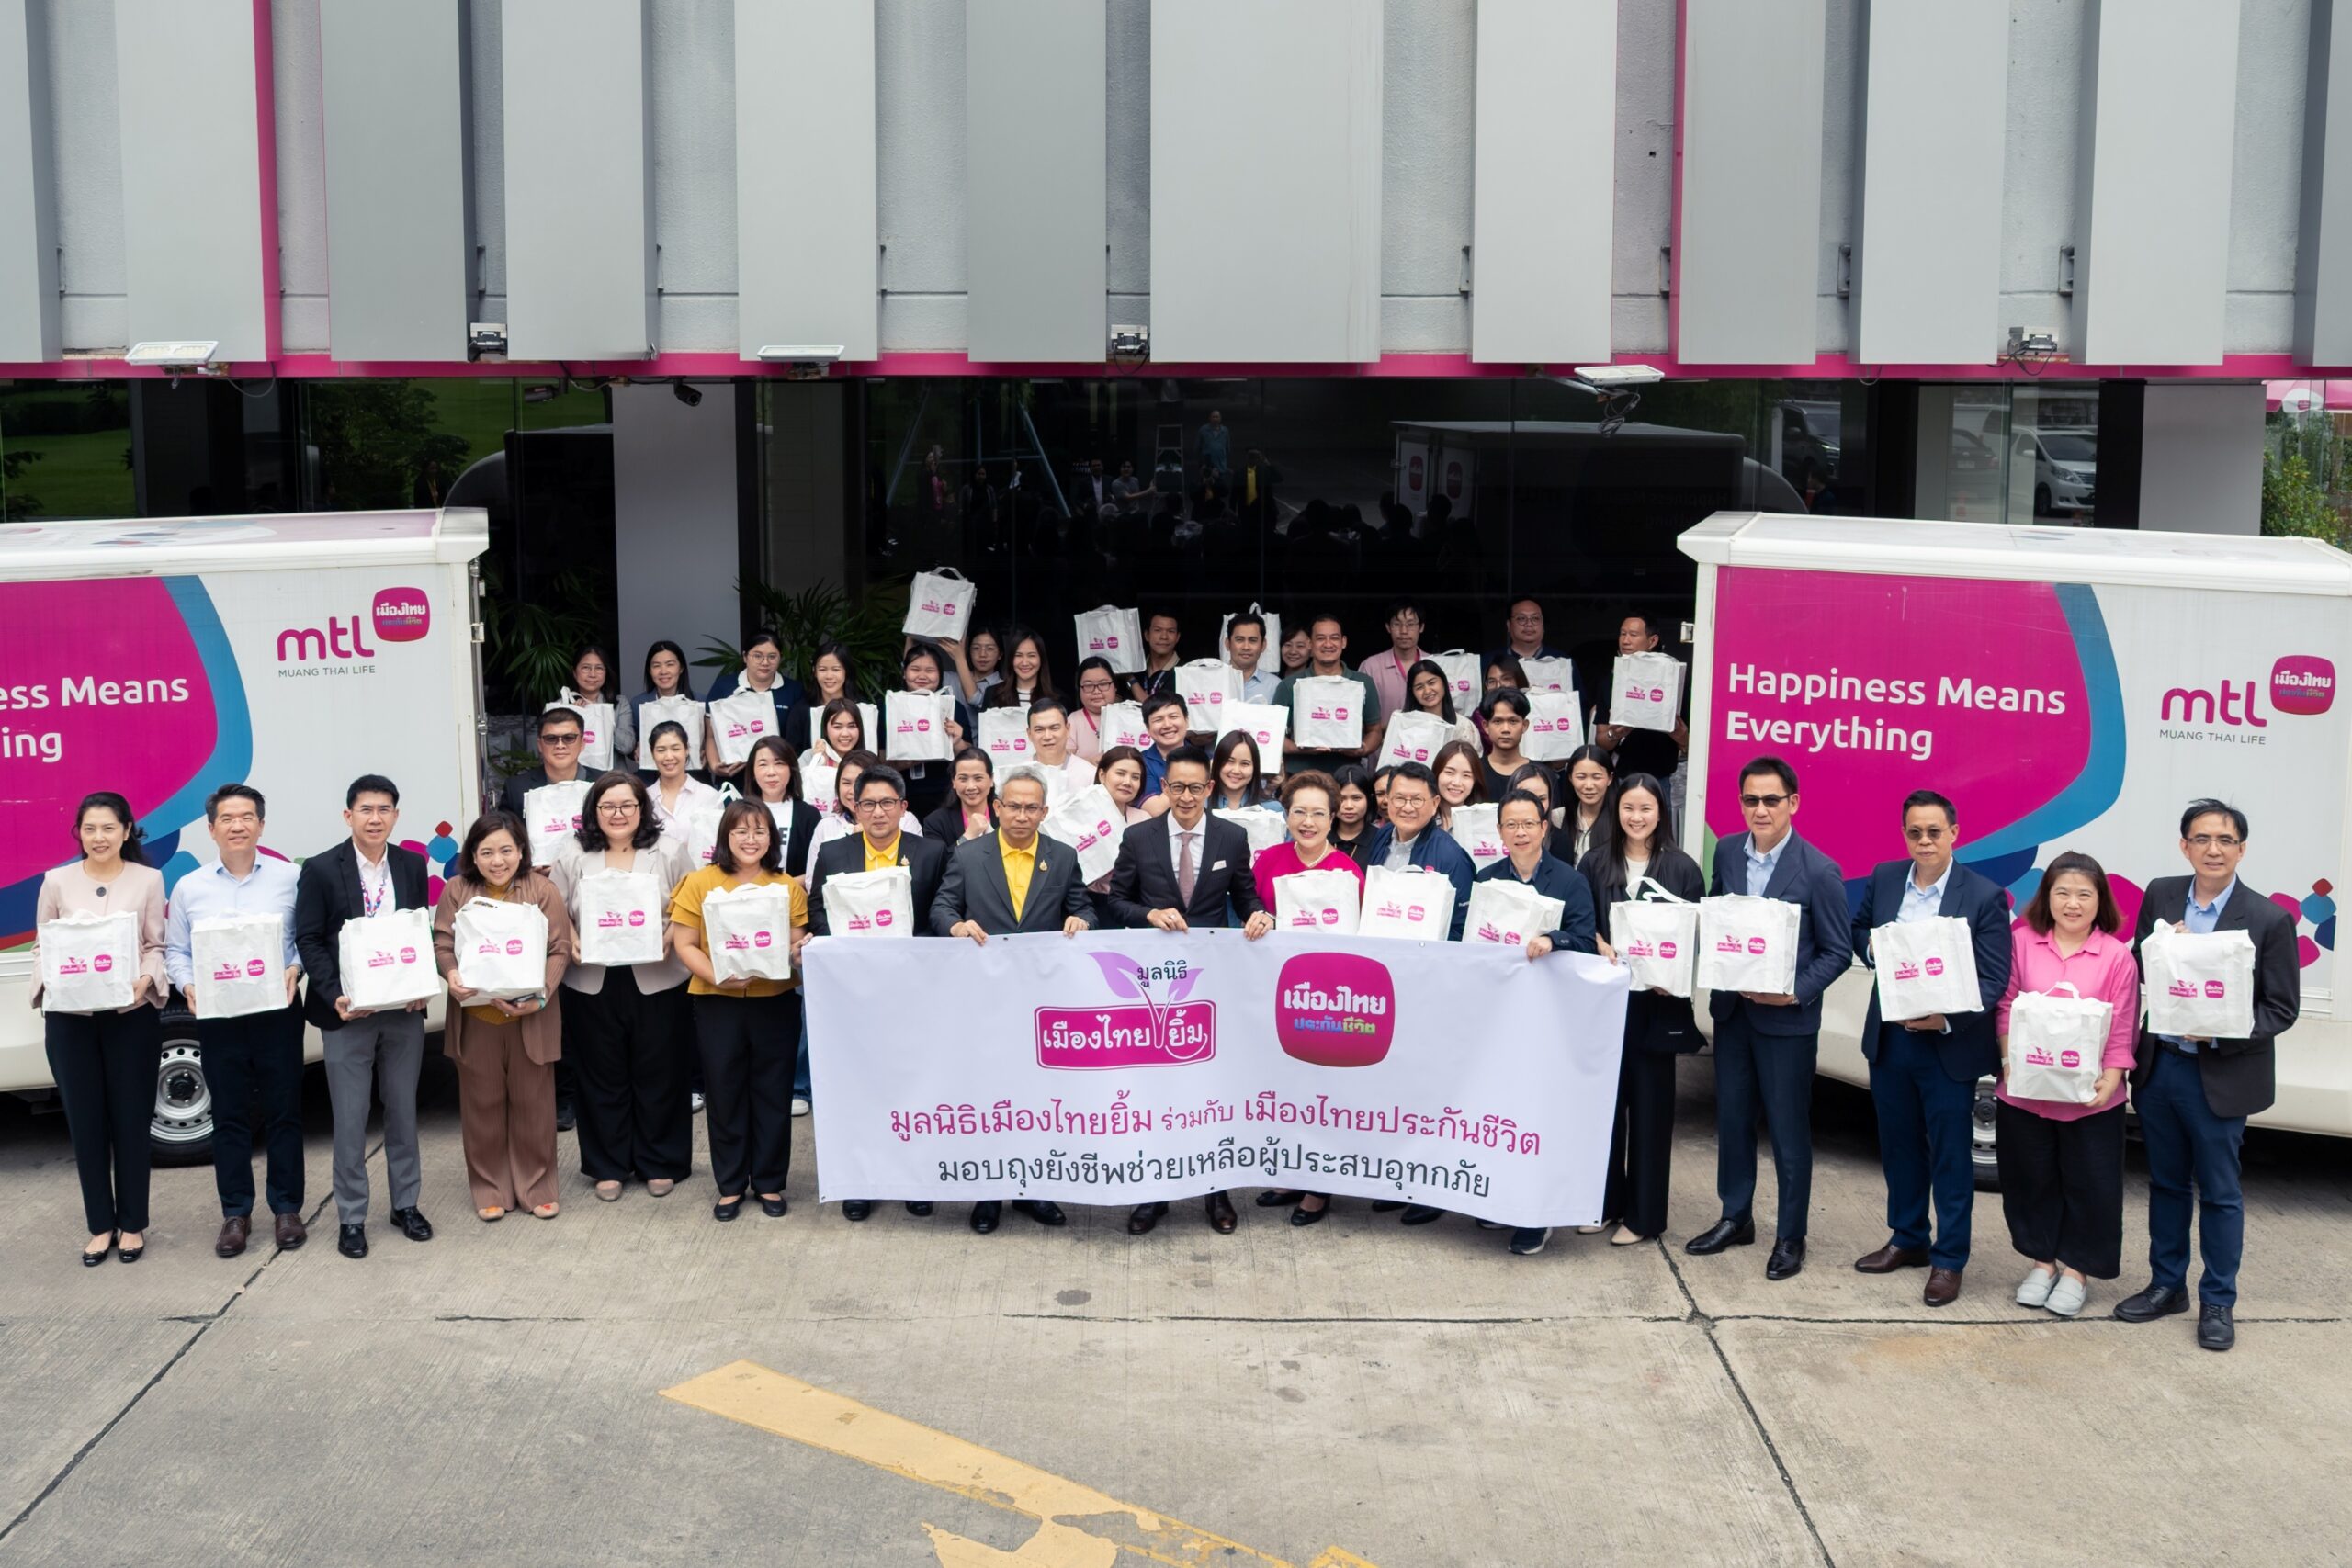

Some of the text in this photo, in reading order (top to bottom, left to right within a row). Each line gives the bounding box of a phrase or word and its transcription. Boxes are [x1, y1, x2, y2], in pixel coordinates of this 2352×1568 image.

[277, 615, 375, 661] mtl
[62, 676, 189, 707] Means
[278, 665, 375, 678] MUANG THAI LIFE
[1729, 663, 2066, 715] Happiness Means
[2161, 680, 2267, 727] mtl
[1726, 710, 1932, 761] Everything
[2159, 729, 2267, 745] MUANG THAI LIFE
[1137, 959, 1188, 988] มูลนิธิ
[1284, 981, 1386, 1015] เมืองไทย
[1043, 1009, 1203, 1049] เมืองไทย ยิ้ม
[890, 1089, 1541, 1156] มูลนิธิเมืองไทยยิ้ม ร่วมกับ เมืองไทยประกันชีวิต
[938, 1136, 1490, 1198] มอบถุงยังชีพช่วยเหลือผู้ประสบอุทกภัย
